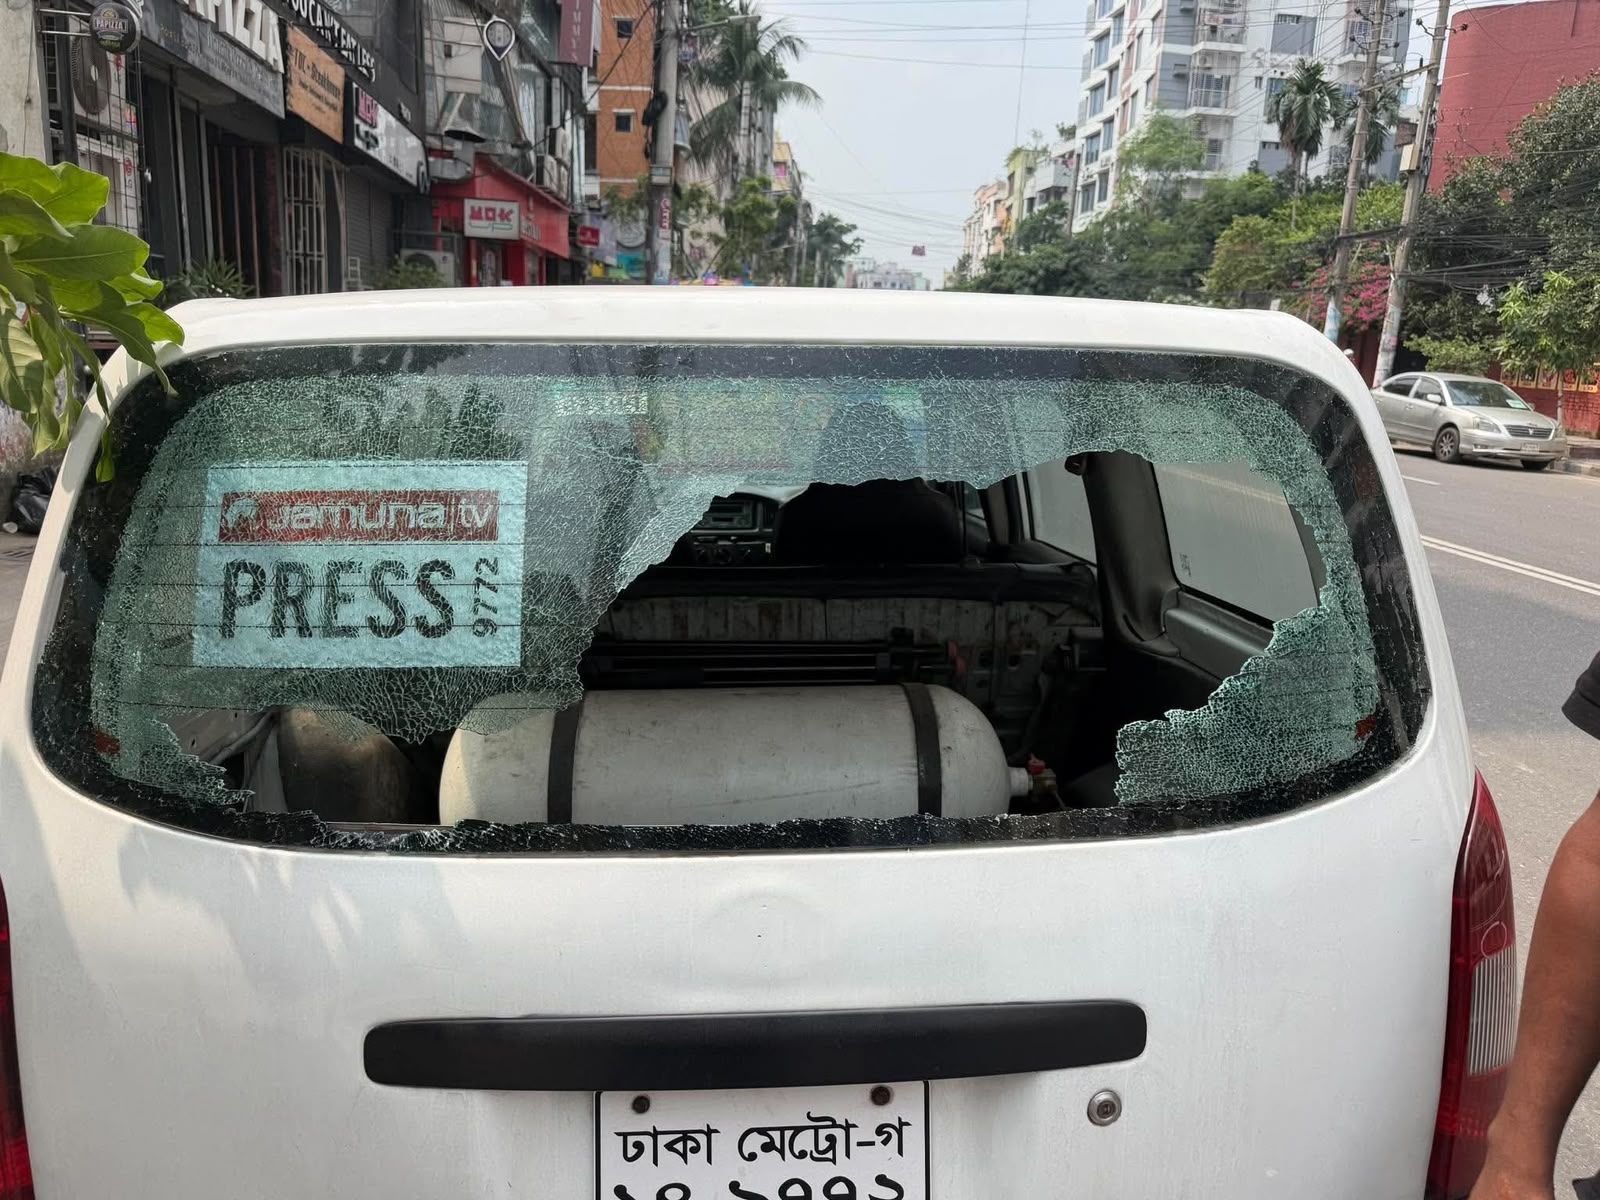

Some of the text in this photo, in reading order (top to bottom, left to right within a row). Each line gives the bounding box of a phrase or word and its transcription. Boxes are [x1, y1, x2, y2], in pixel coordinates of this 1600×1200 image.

[95, 18, 125, 30] PAPIZZA
[219, 558, 456, 639] PRESS
[472, 556, 499, 638] 9772
[614, 1123, 721, 1168] ঢাকা
